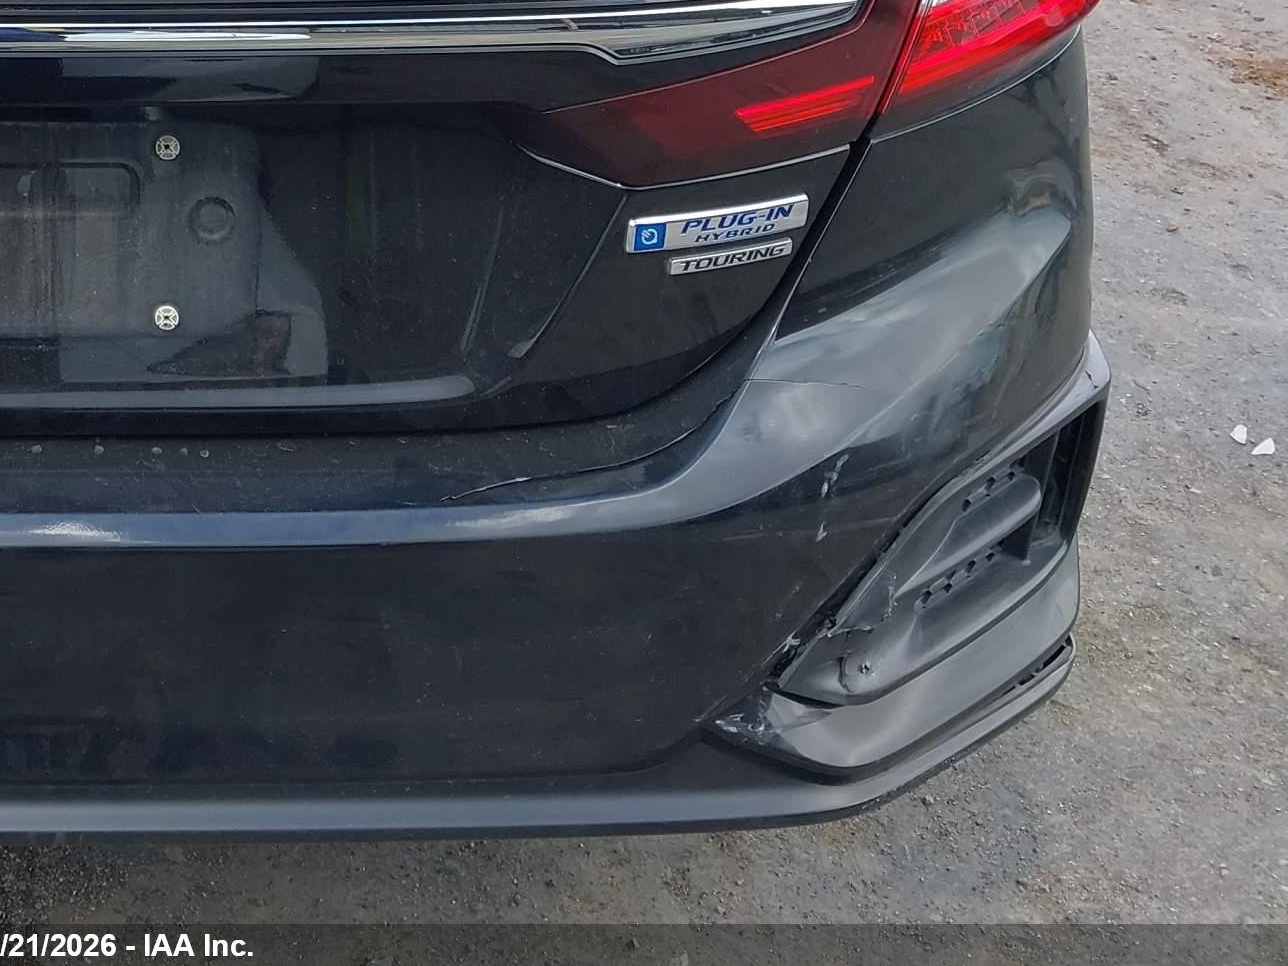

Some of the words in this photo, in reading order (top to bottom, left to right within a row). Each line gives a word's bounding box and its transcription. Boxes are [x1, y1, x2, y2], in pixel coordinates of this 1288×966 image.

[680, 205, 793, 234] PLUG-IN
[694, 223, 776, 243] HYBRID
[680, 245, 786, 272] TOURING
